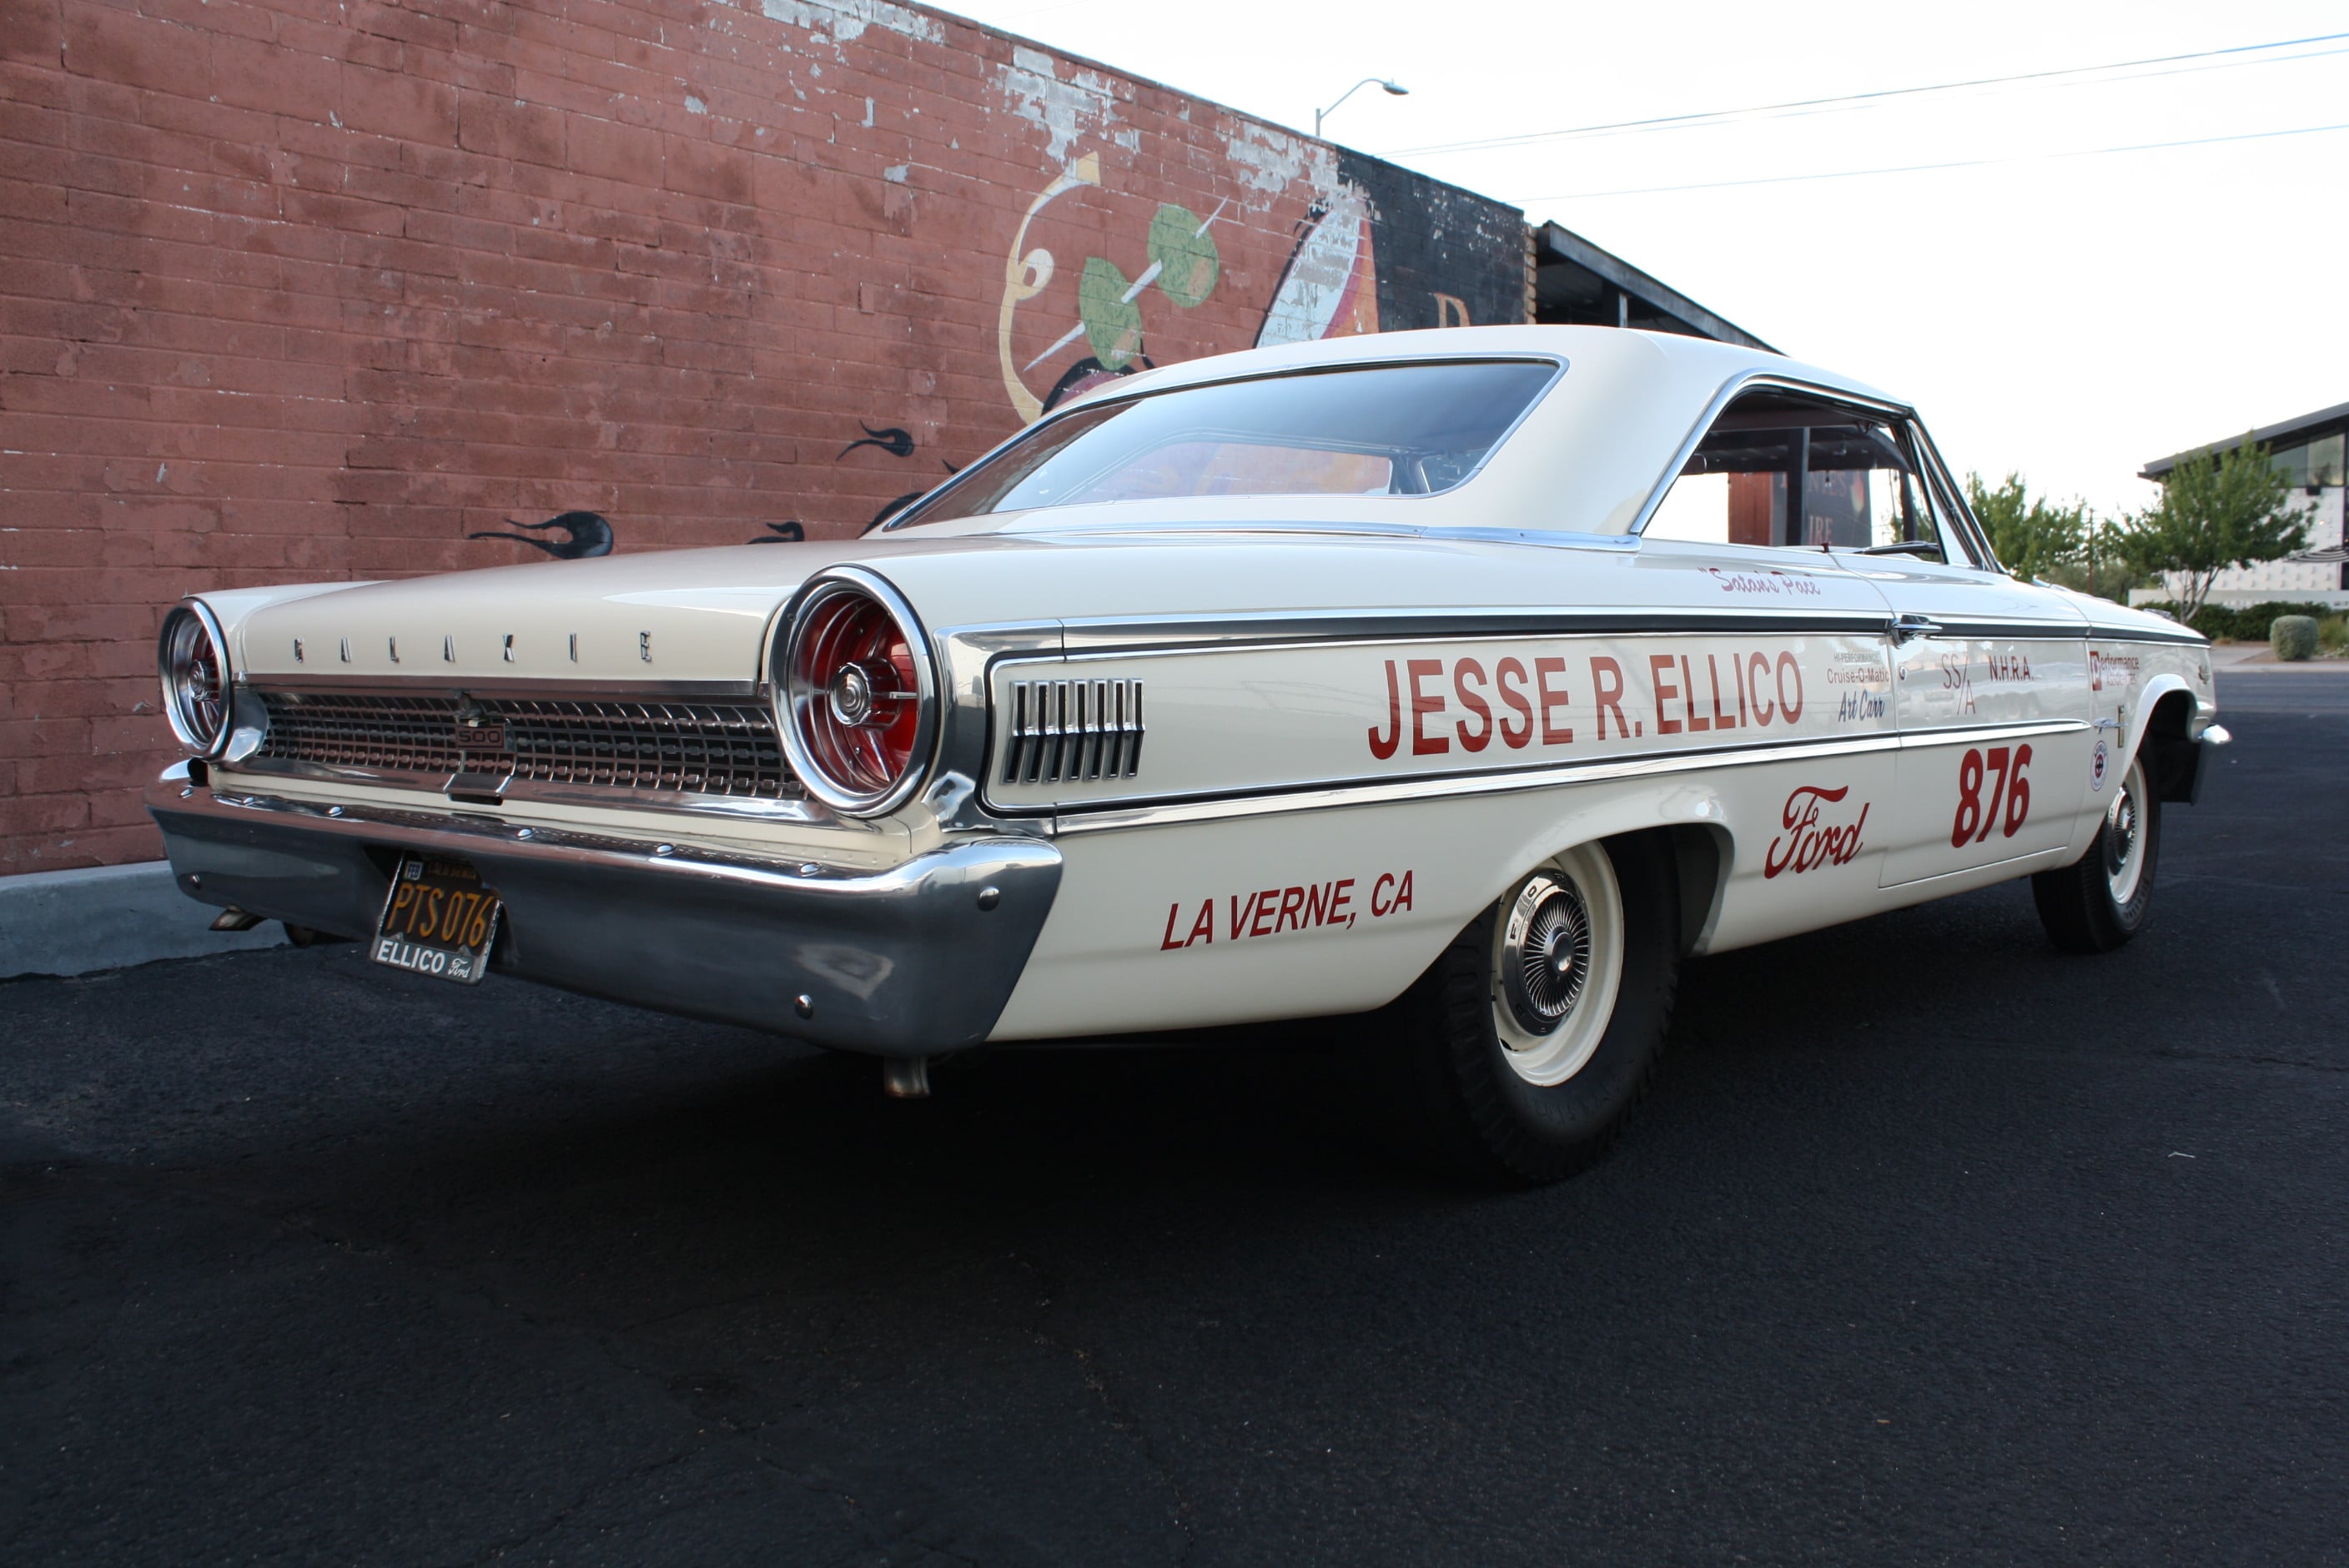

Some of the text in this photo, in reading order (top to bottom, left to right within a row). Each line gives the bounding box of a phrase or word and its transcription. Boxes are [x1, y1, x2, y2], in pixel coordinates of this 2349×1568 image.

[294, 629, 652, 664] GALAXIE
[1827, 666, 1890, 685] Cruise-O-Matic
[1989, 655, 2034, 681] N.H.R.A.
[1368, 651, 1803, 760] JESSE R. ELLICO
[1838, 688, 1886, 723] Art Carr
[459, 731, 500, 743] 500
[1950, 743, 2033, 848] 876
[1764, 785, 1870, 879] Ford
[386, 882, 495, 947] PTS 076
[1160, 870, 1413, 951] LA VERNE, CA
[376, 939, 471, 979] ELLICO Ford
